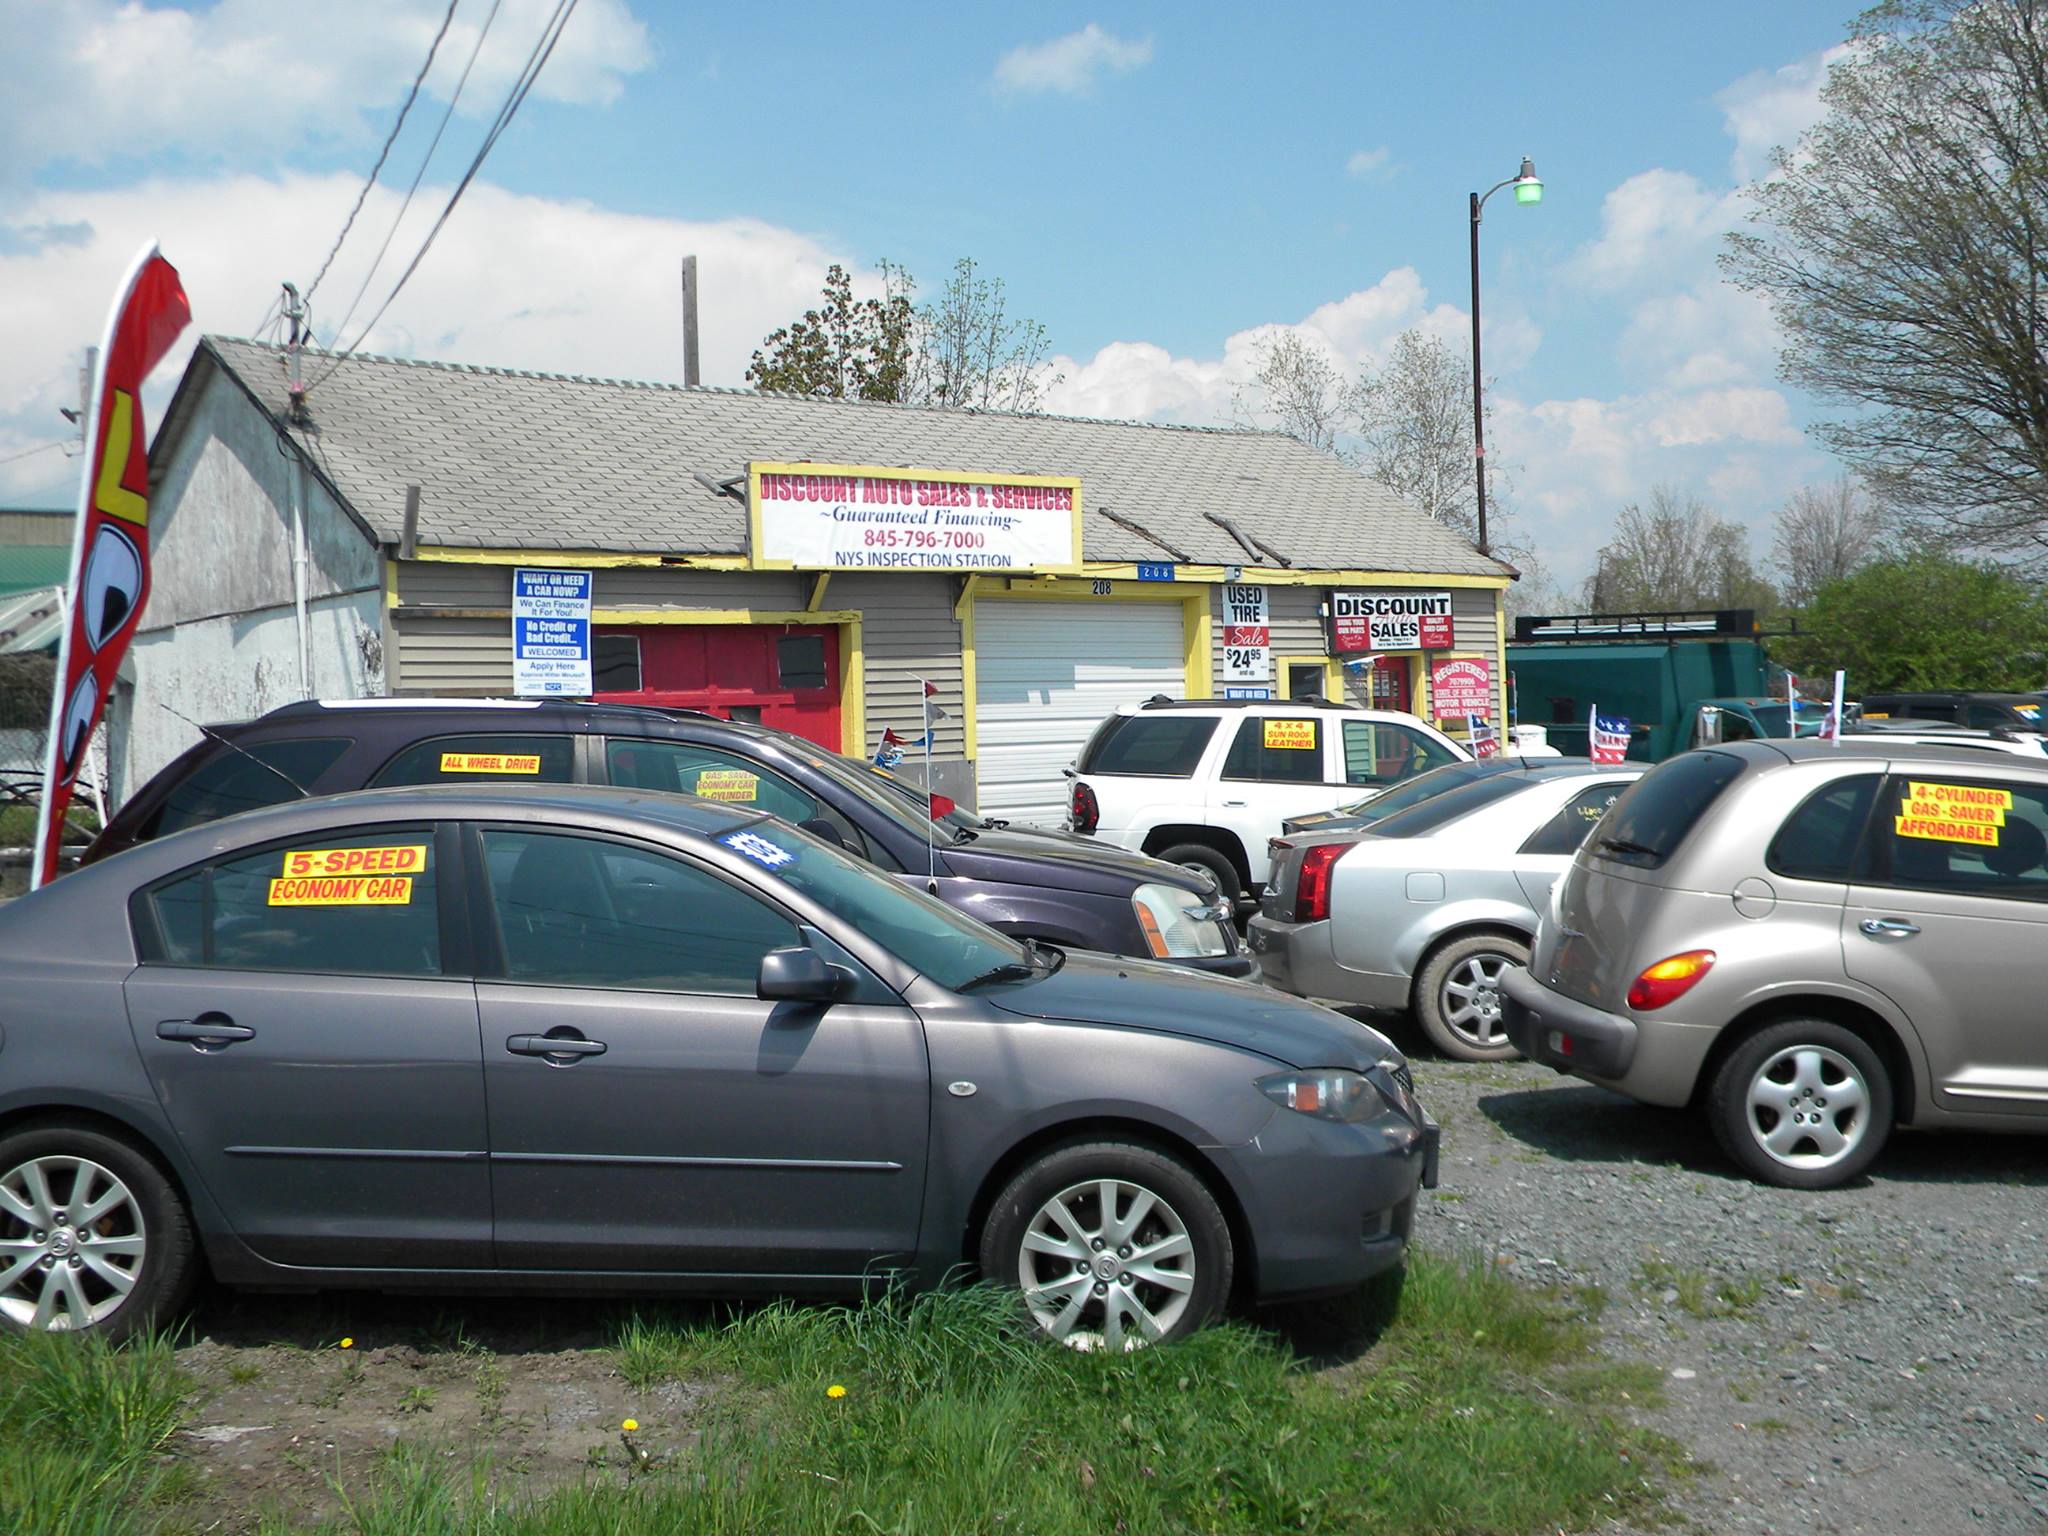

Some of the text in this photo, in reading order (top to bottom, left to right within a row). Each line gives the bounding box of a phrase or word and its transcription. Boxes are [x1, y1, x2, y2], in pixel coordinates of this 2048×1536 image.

[760, 473, 1072, 511] DISCOUNT AUTO SALES & SERVICES
[864, 529, 984, 549] 845-796-7000
[835, 551, 1011, 567] NYS INSPECTION STATION
[522, 573, 585, 586] WANT OR NEED
[527, 585, 579, 597] A CAR NOW?
[1093, 581, 1112, 595] 208
[1228, 586, 1262, 604] USED
[520, 599, 585, 609] We Can Finance
[1337, 598, 1449, 616] DISCOUNT
[540, 608, 553, 616] For
[1231, 605, 1260, 622] TIRE
[526, 620, 577, 632] No Credit or
[1371, 622, 1418, 638] SALES
[526, 632, 543, 643] Bad
[1231, 626, 1264, 646] Sale
[528, 647, 577, 657] WELCOMED
[530, 661, 575, 671] Apply Here
[1433, 661, 1488, 684] REGISTERED
[1435, 698, 1490, 708] MOTOR VEHICLE
[1440, 708, 1461, 717] RETAIL
[1266, 739, 1313, 747] LEATHER
[445, 756, 537, 769] ALL WHEEL DRIVE
[699, 780, 754, 789] ECONOMY CAR
[1915, 785, 2005, 806] 4-CYLINDER
[1900, 818, 1994, 842] AFFORDABLE
[290, 848, 417, 875] 5-SPEED
[272, 878, 407, 899] ECONOMY CAR
